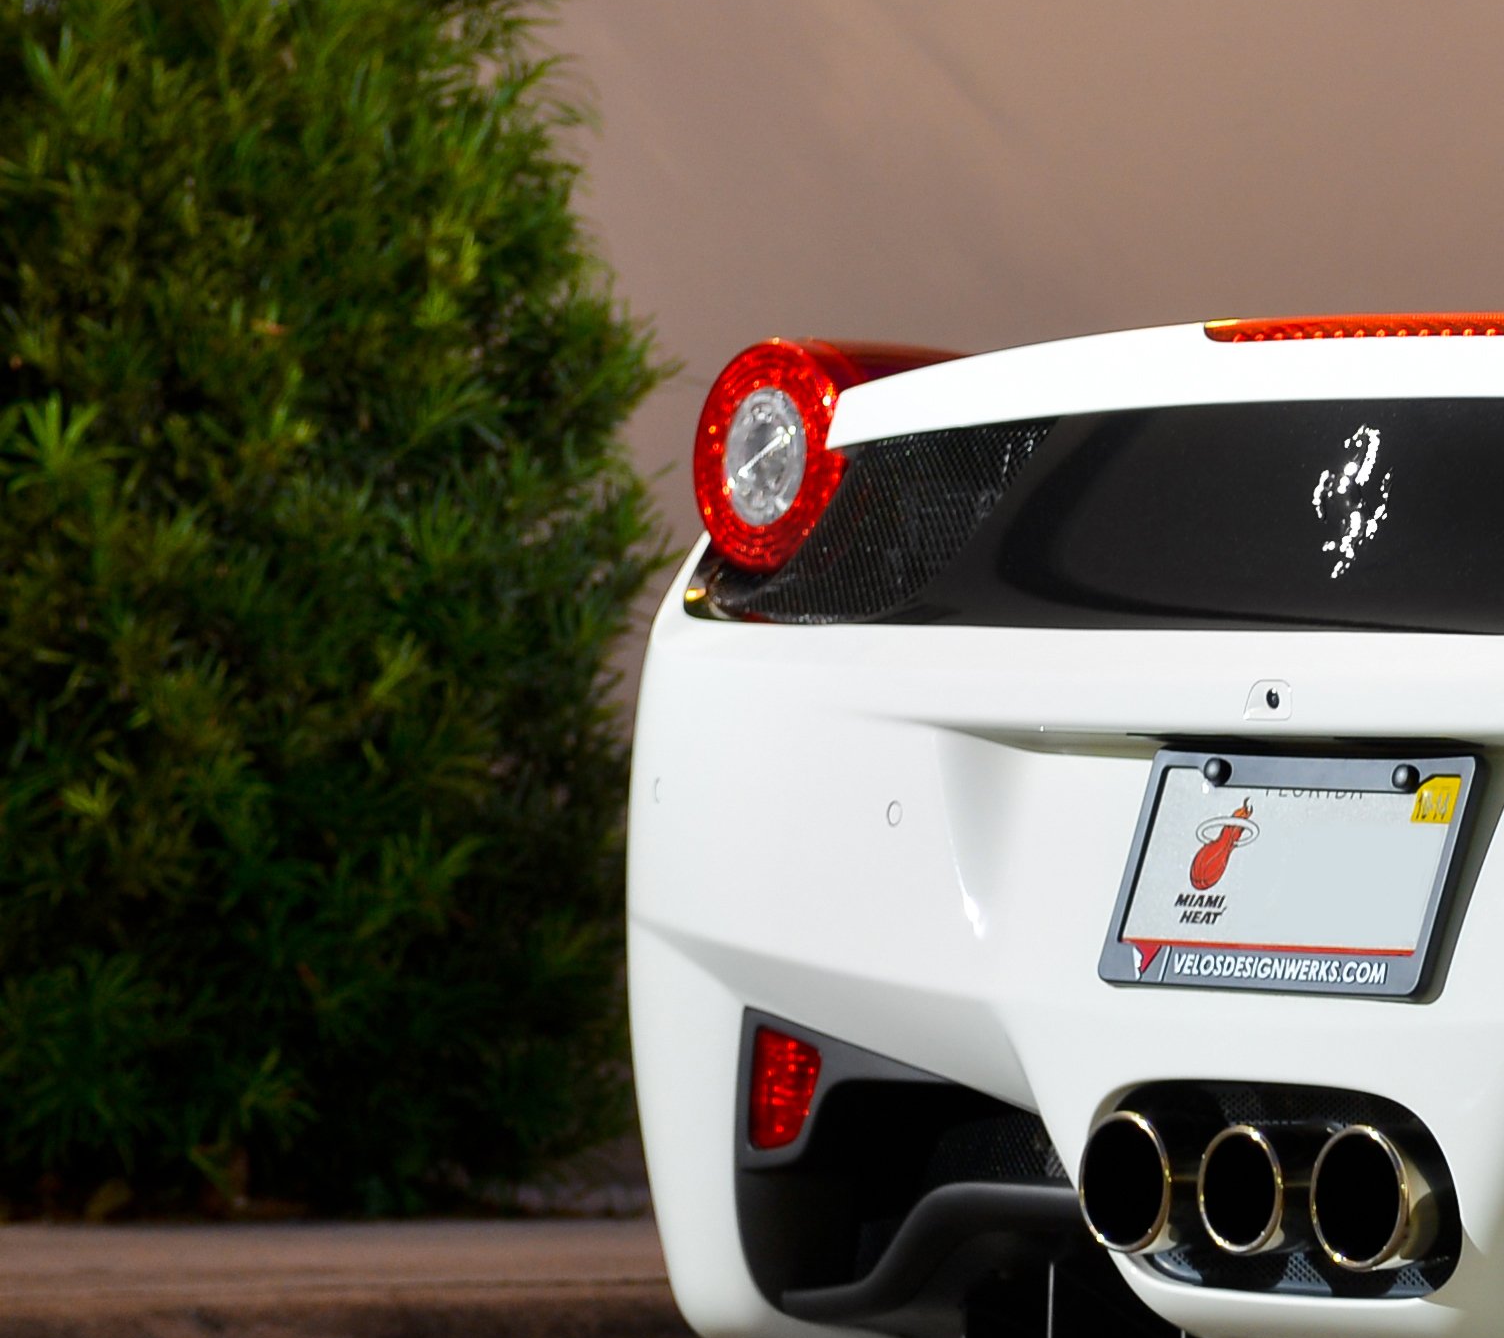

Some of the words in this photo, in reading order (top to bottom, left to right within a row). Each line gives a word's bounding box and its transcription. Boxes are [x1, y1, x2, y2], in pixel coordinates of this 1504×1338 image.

[1173, 892, 1227, 910] MIAMI
[1178, 908, 1227, 926] HEAT
[1172, 952, 1389, 986] VELOSDESIGNWERKS.COM
